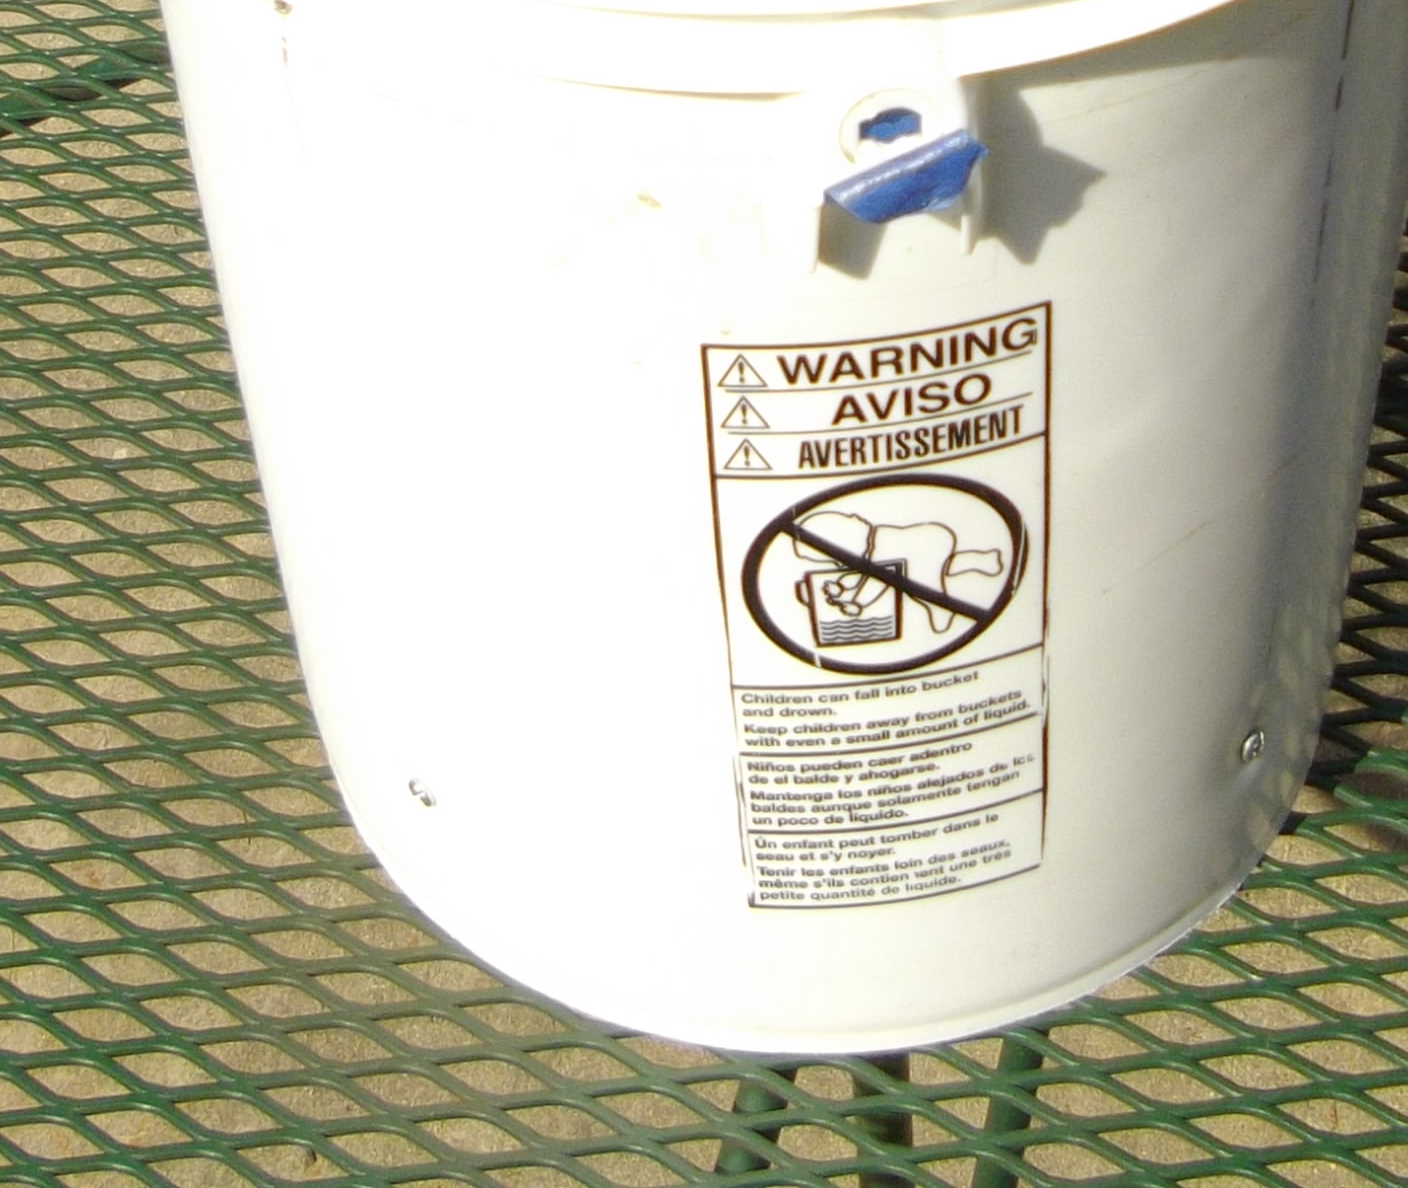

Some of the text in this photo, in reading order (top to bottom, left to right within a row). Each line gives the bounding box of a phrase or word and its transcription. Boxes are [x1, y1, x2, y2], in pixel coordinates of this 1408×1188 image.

[777, 318, 1038, 386] WARNING
[831, 373, 992, 426] AVISO
[798, 404, 1025, 469] AVERTISSEMENT
[741, 671, 979, 704] Children can fall into bucket
[742, 706, 838, 717] and drown.
[744, 690, 1022, 736] Keep children away from buckets
[745, 699, 1031, 747] with even a small amount of liquid.
[747, 742, 973, 774] Niños pueden caer adentro
[748, 762, 941, 785] de el balde y ahogarse.
[750, 790, 834, 803] Mantenga
[837, 788, 863, 799] los
[867, 783, 913, 797] niños
[917, 768, 985, 790] alejados
[989, 762, 1009, 774] de
[751, 770, 1021, 818] baldes aunque solamente tengan
[752, 817, 773, 825] un
[777, 816, 819, 828] poco
[823, 813, 845, 824] de
[781, 839, 834, 850] enfant
[838, 836, 876, 850] peut
[880, 827, 939, 844] tomber
[942, 818, 981, 834] dans
[985, 813, 1000, 824] le
[755, 846, 896, 862] seau et s'y noyer.
[756, 865, 796, 877] Tenir
[801, 867, 825, 877] les
[829, 862, 890, 876] enfants
[894, 858, 924, 870] loin
[927, 852, 956, 865] des
[758, 878, 809, 888] même
[813, 877, 845, 888] s'ils
[949, 858, 978, 872] une
[982, 848, 1012, 865] très
[760, 891, 806, 901] petite
[810, 887, 876, 901] quantité
[880, 884, 900, 896] de
